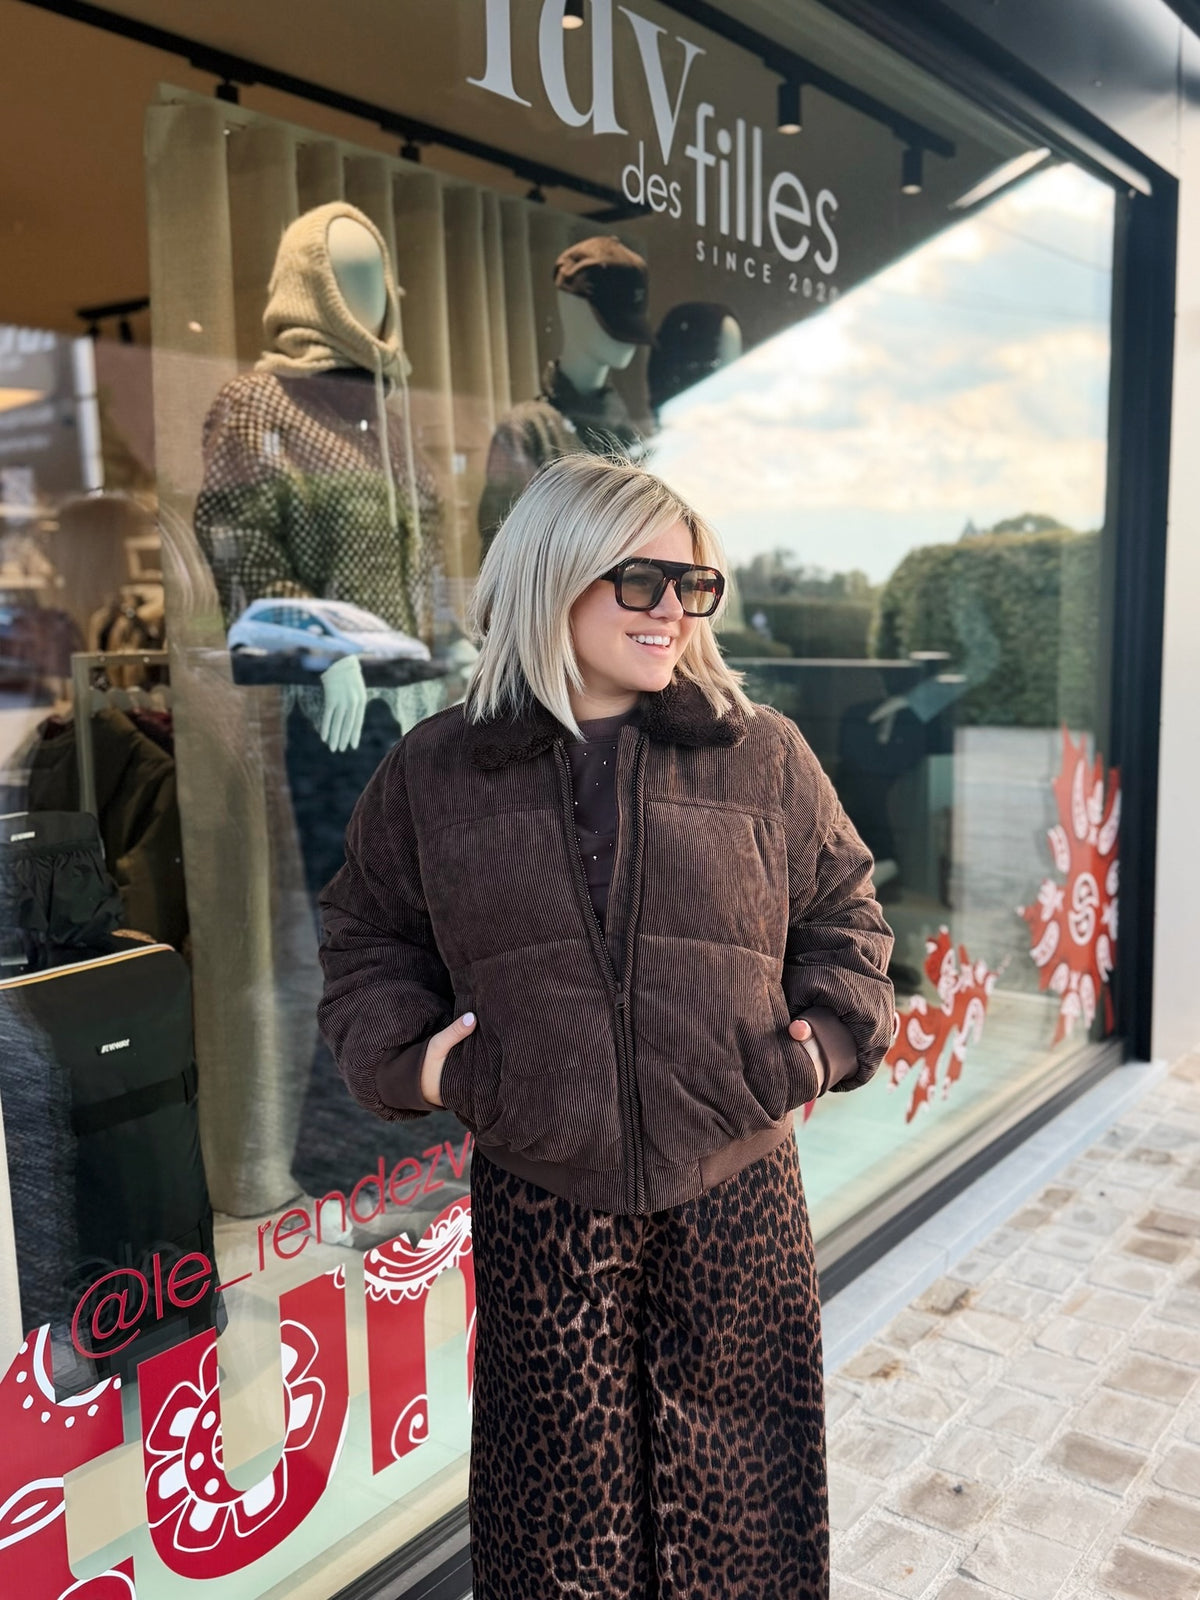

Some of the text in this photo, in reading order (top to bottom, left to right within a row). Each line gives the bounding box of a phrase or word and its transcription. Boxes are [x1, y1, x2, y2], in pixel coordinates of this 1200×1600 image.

[621, 102, 839, 275] des filles
[696, 240, 772, 284] SINCE
[71, 1131, 475, 1359] @le_rendezv
